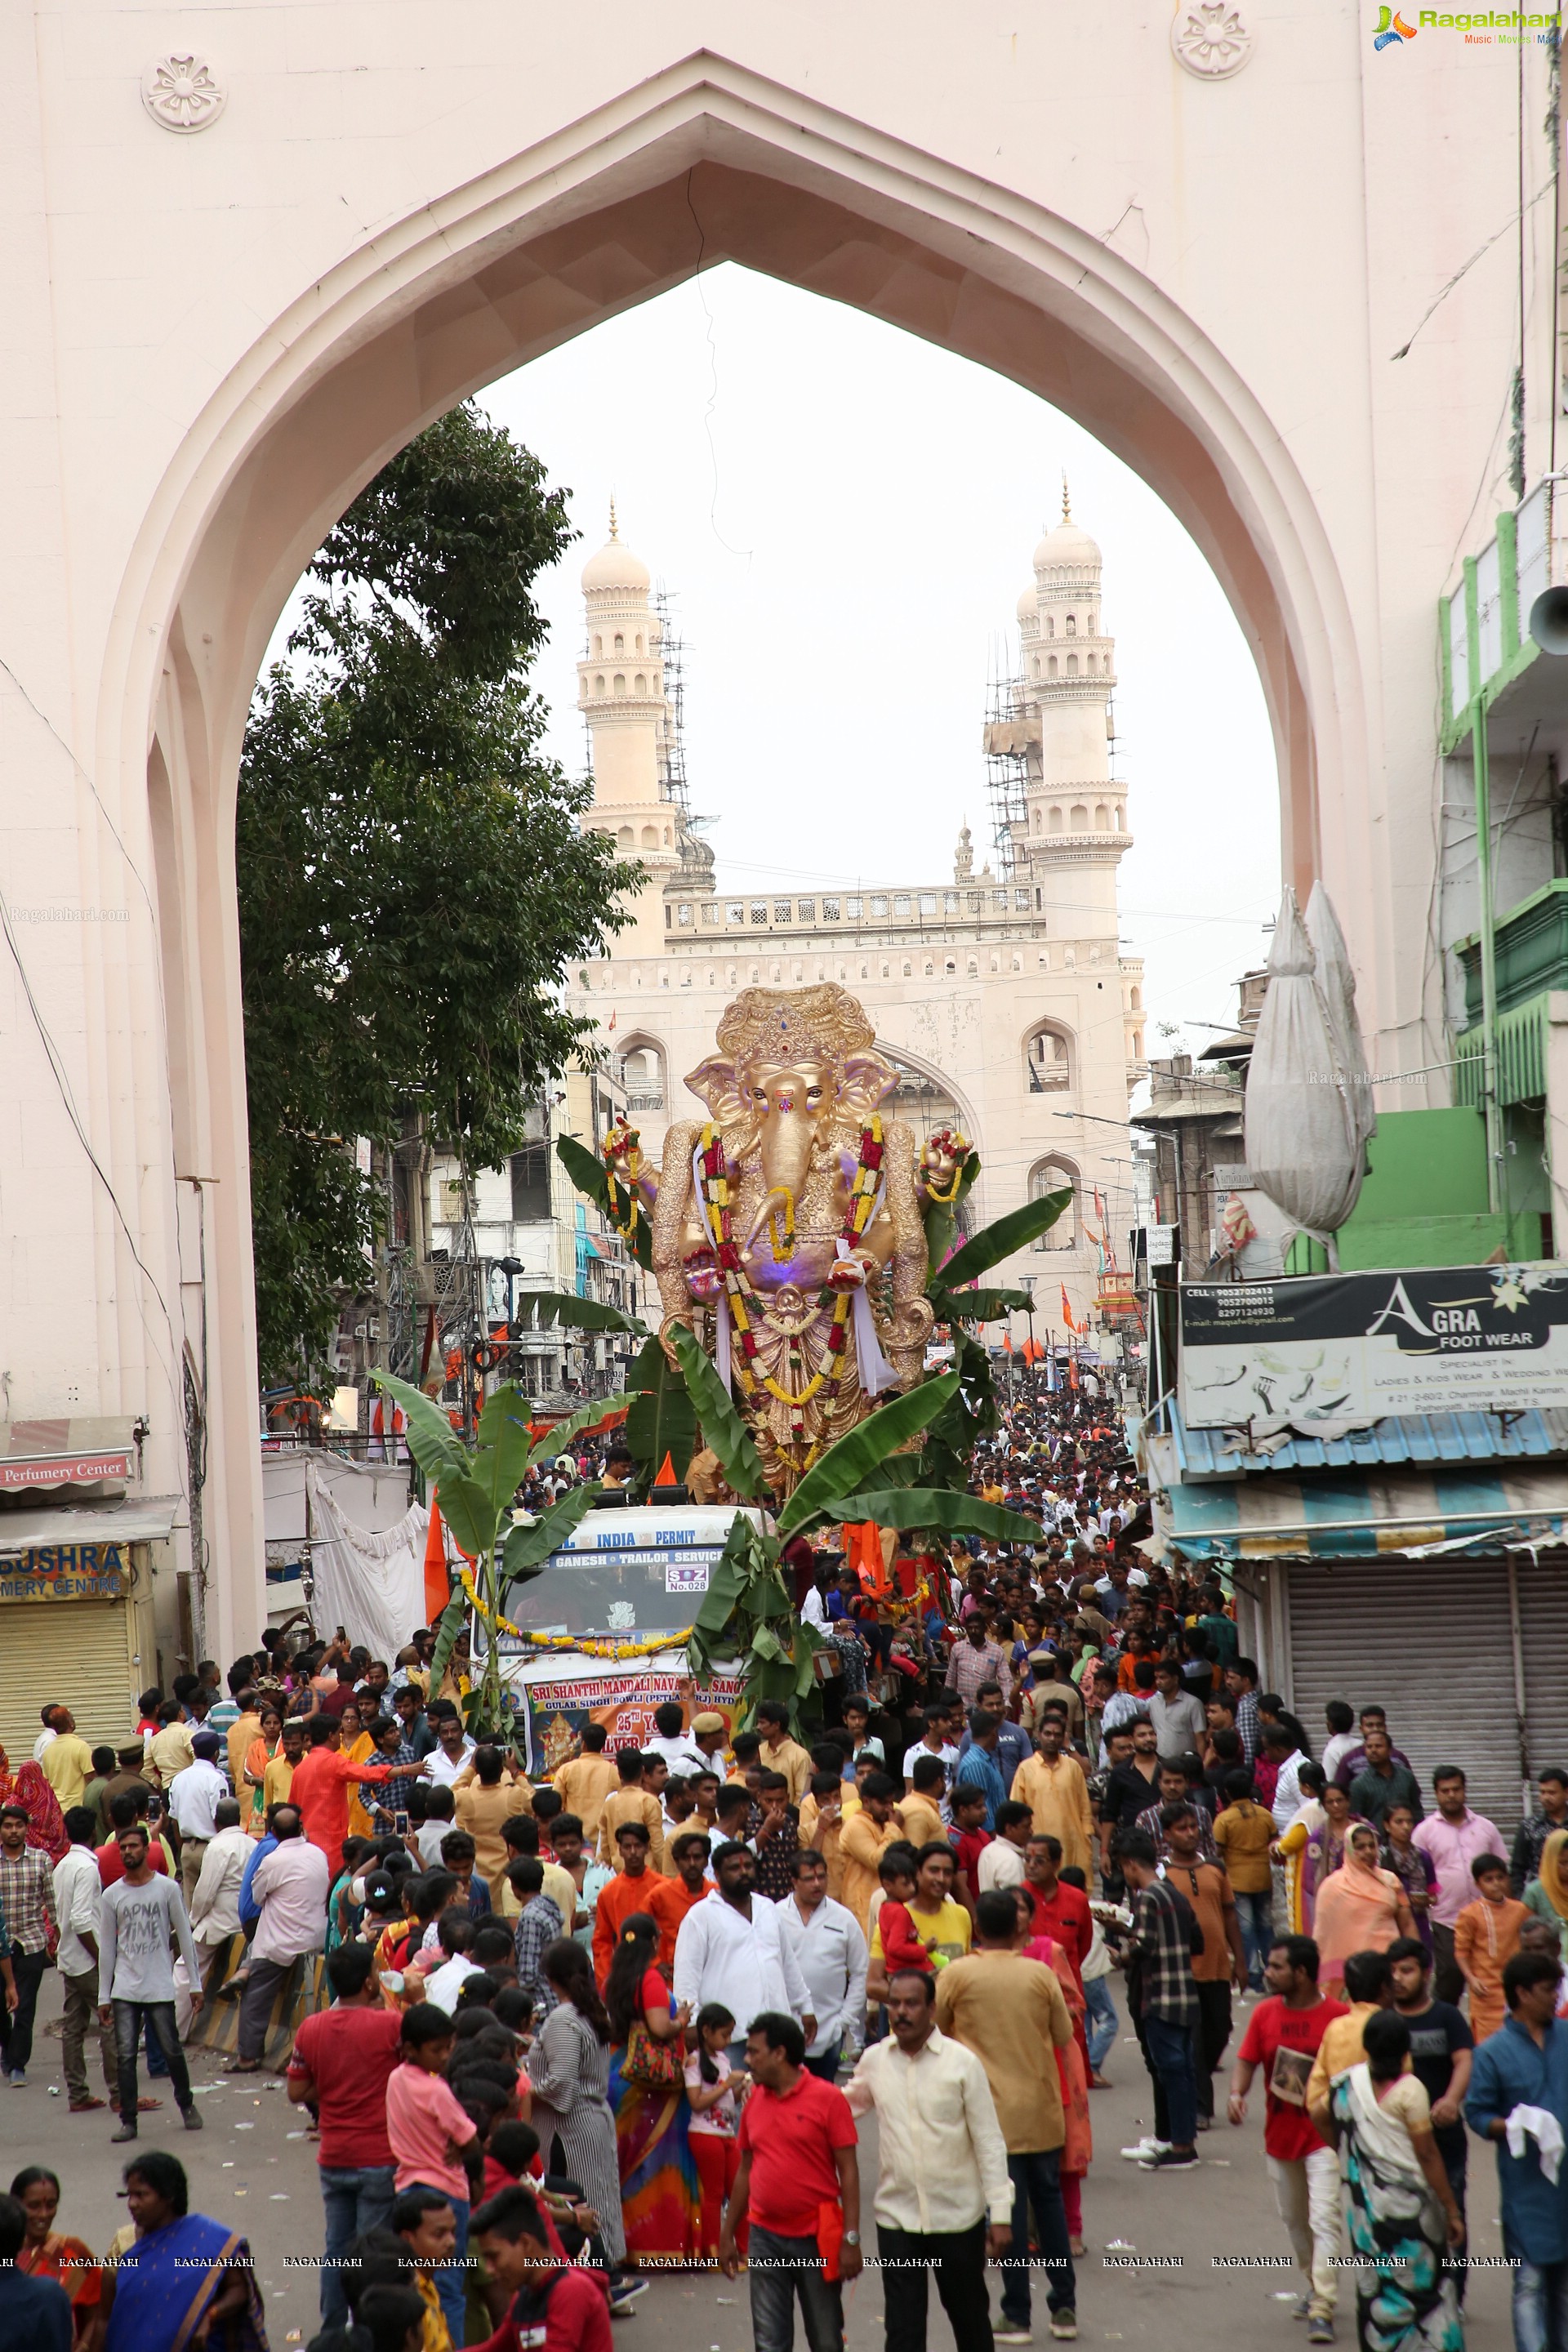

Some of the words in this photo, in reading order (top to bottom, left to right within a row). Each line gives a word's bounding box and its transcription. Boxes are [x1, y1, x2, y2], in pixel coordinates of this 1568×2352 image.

[1187, 1289, 1210, 1297] CELL
[1217, 1287, 1273, 1296] 9052702413
[1218, 1297, 1274, 1307] 9052700015
[1218, 1307, 1275, 1317] 8297124930
[1440, 1334, 1483, 1348] FOOT
[1486, 1332, 1534, 1346] WEAR
[1414, 1374, 1423, 1383] &
[1454, 1371, 1483, 1381] WEAR
[1492, 1370, 1499, 1379] &
[5, 1467, 73, 1481] Perfumery
[77, 1463, 122, 1477] Center
[597, 1532, 635, 1548] INDIA
[656, 1530, 695, 1544] PERMIT
[555, 1555, 607, 1568] GANESH
[619, 1552, 669, 1563] TRAILOR
[53, 1576, 121, 1595] CENTRE
[688, 1582, 706, 1590] 028
[532, 1686, 551, 1701] SRI
[554, 1682, 600, 1699] SHANTHI
[604, 1677, 650, 1692] MANDALI
[546, 1701, 577, 1709] GULAB
[580, 1698, 610, 1708] SINGH
[613, 1695, 643, 1705] BOWLI
[646, 1694, 680, 1704] (PETLA
[123, 1901, 161, 1921] APNA
